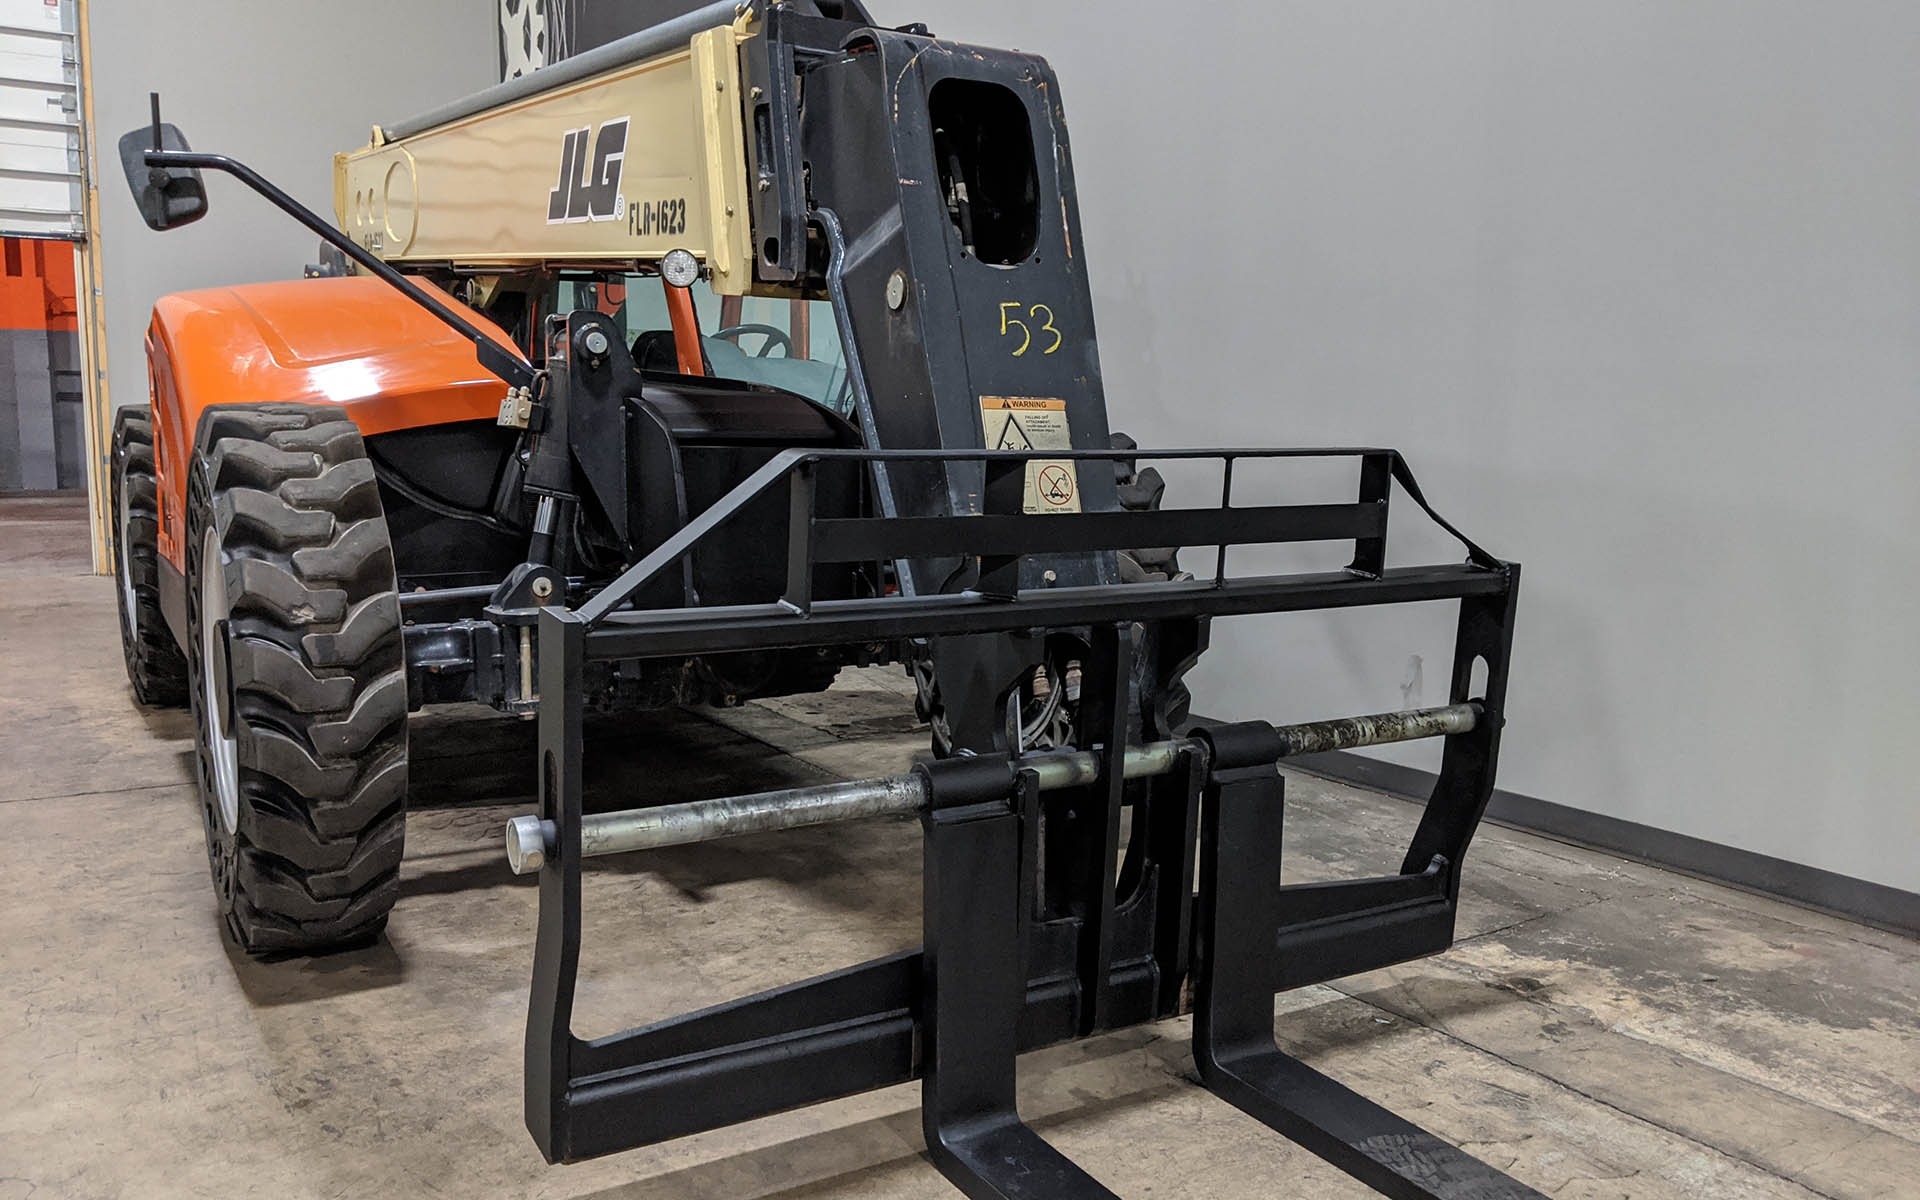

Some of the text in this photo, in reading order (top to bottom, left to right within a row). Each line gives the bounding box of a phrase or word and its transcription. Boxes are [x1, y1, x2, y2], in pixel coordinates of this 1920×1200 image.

[548, 117, 629, 222] JLG
[629, 198, 685, 236] FLR-1623
[1000, 302, 1061, 356] 53
[1011, 400, 1047, 408] WARNING
